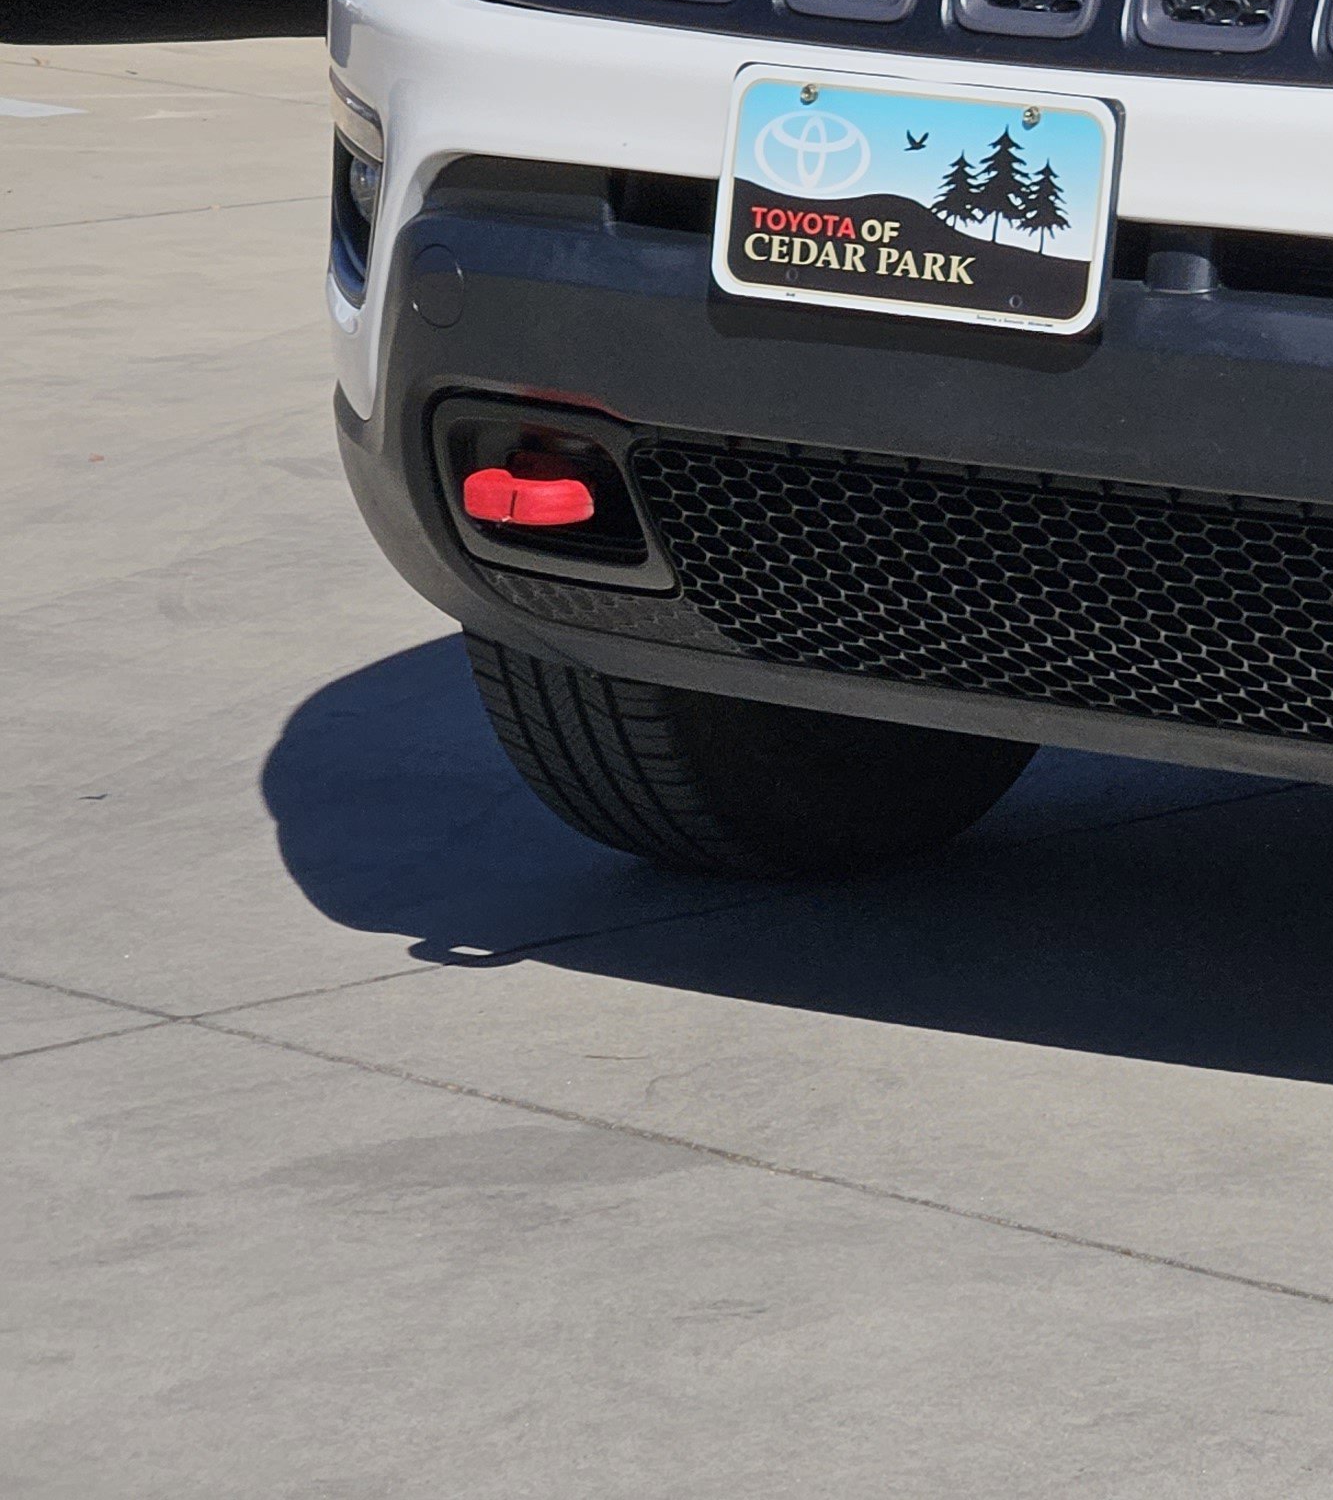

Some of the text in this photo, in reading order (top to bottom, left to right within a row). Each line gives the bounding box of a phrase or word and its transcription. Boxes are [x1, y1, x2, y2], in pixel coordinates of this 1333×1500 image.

[751, 206, 901, 243] TOYOTA OF
[744, 232, 977, 286] CEDAR PARK
